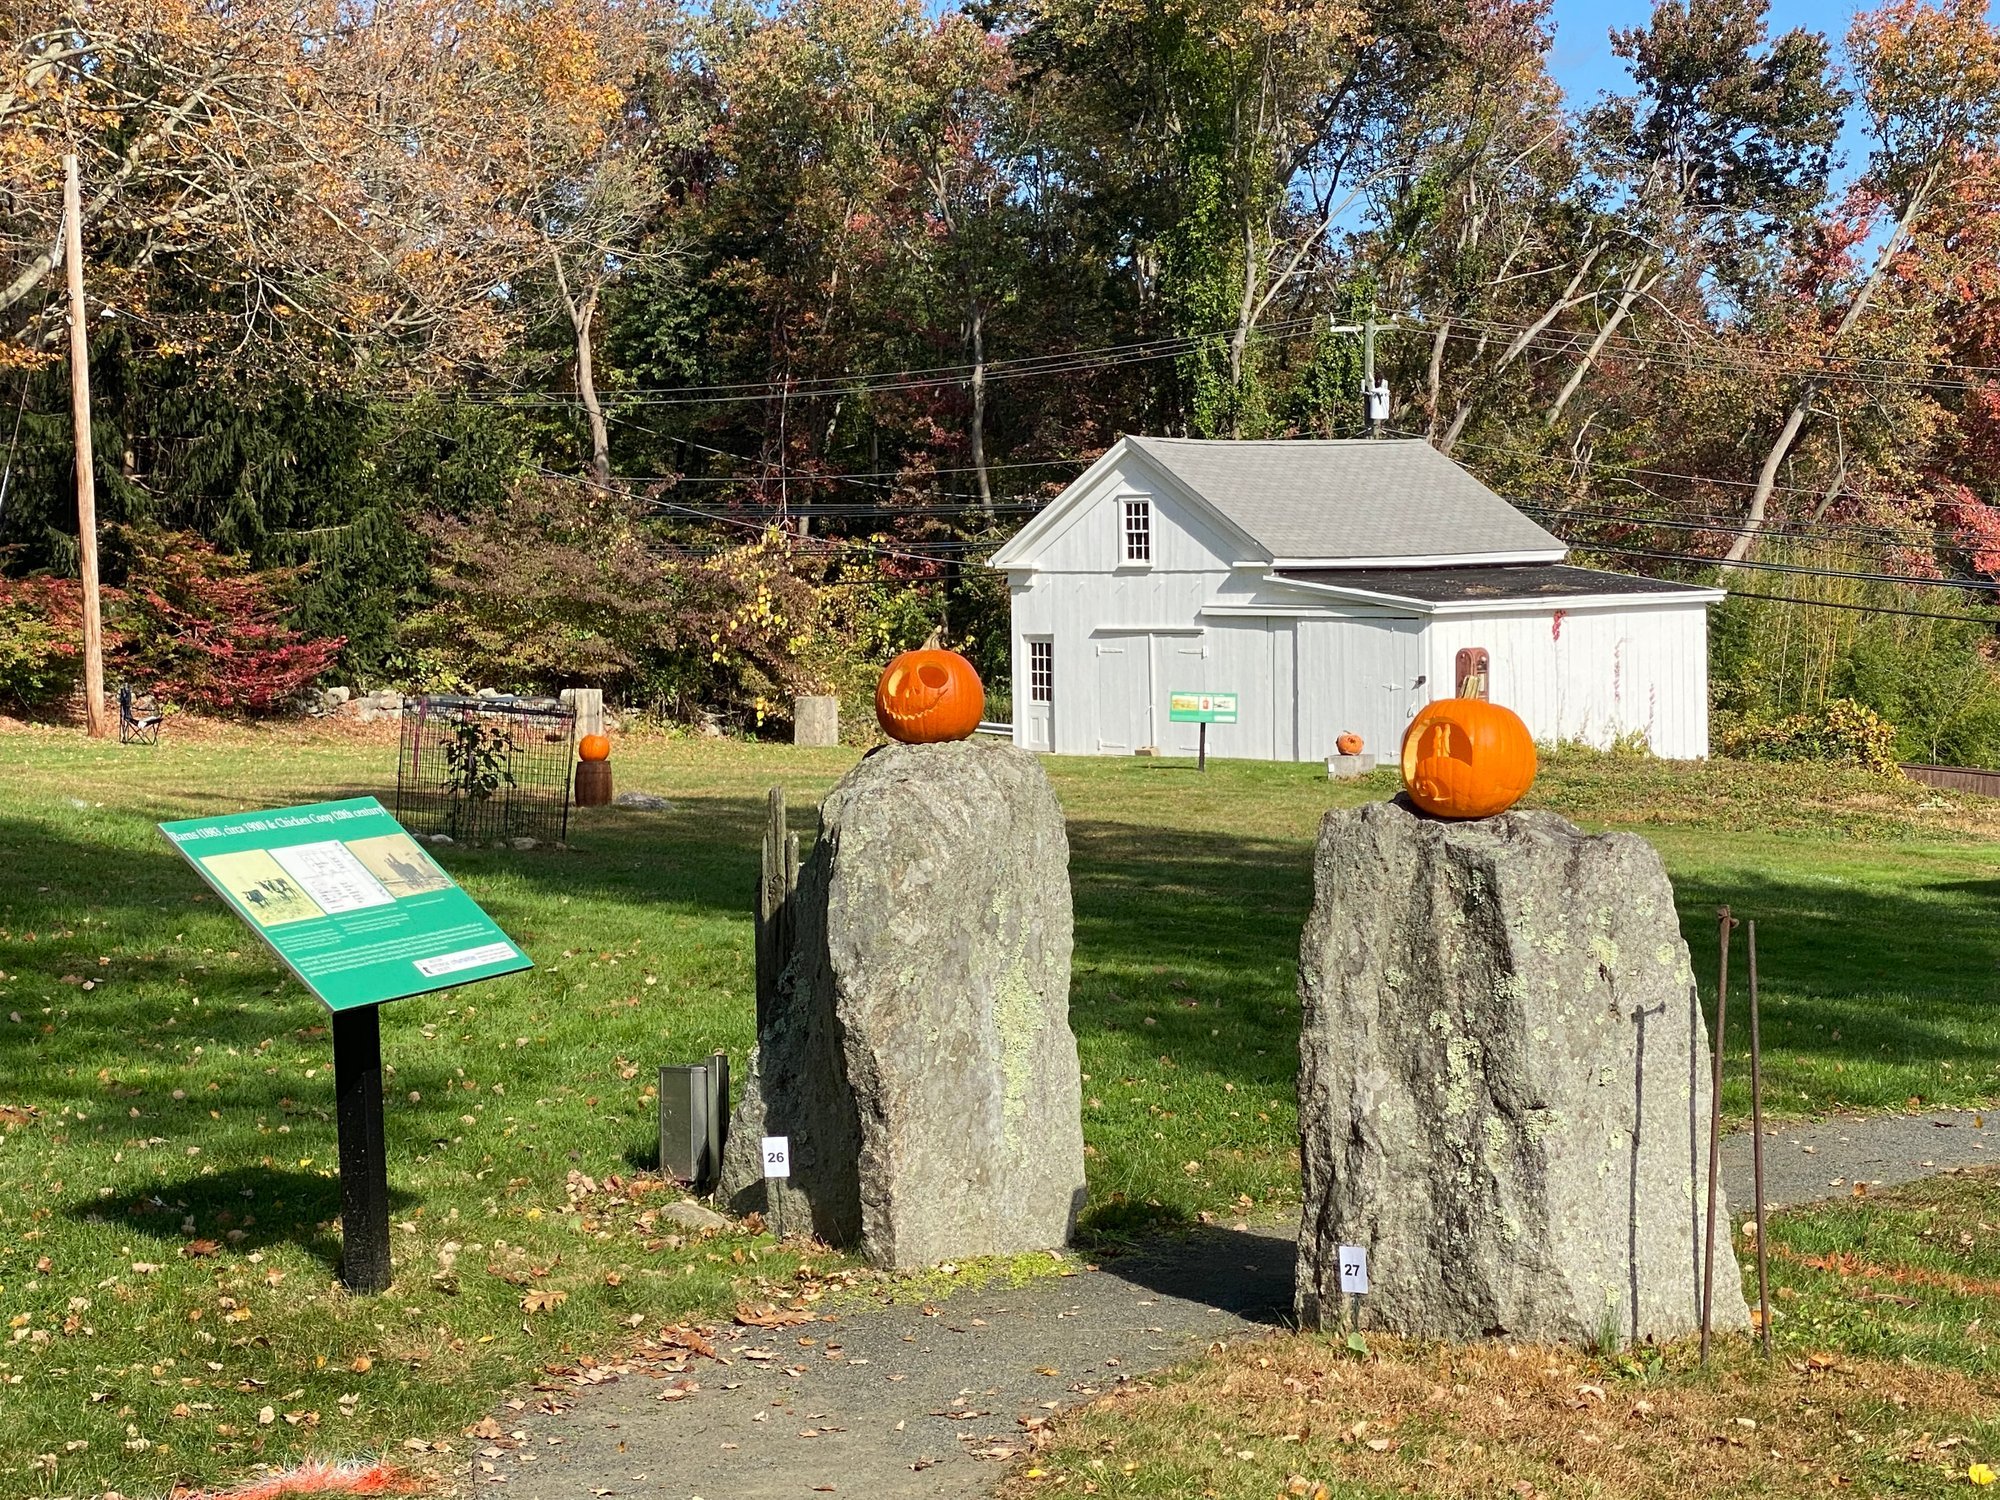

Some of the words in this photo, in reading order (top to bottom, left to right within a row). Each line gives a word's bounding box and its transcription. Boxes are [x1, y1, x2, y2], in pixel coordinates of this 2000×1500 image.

[169, 831, 199, 841] Barns
[224, 824, 247, 836] circa
[243, 820, 268, 832] 1900)
[266, 819, 277, 829] &
[275, 816, 312, 828] Chicken
[309, 814, 334, 824] Coop
[331, 809, 354, 820] (20th
[353, 804, 386, 817] century)
[767, 1152, 785, 1163] 26
[1344, 1263, 1360, 1277] 27
